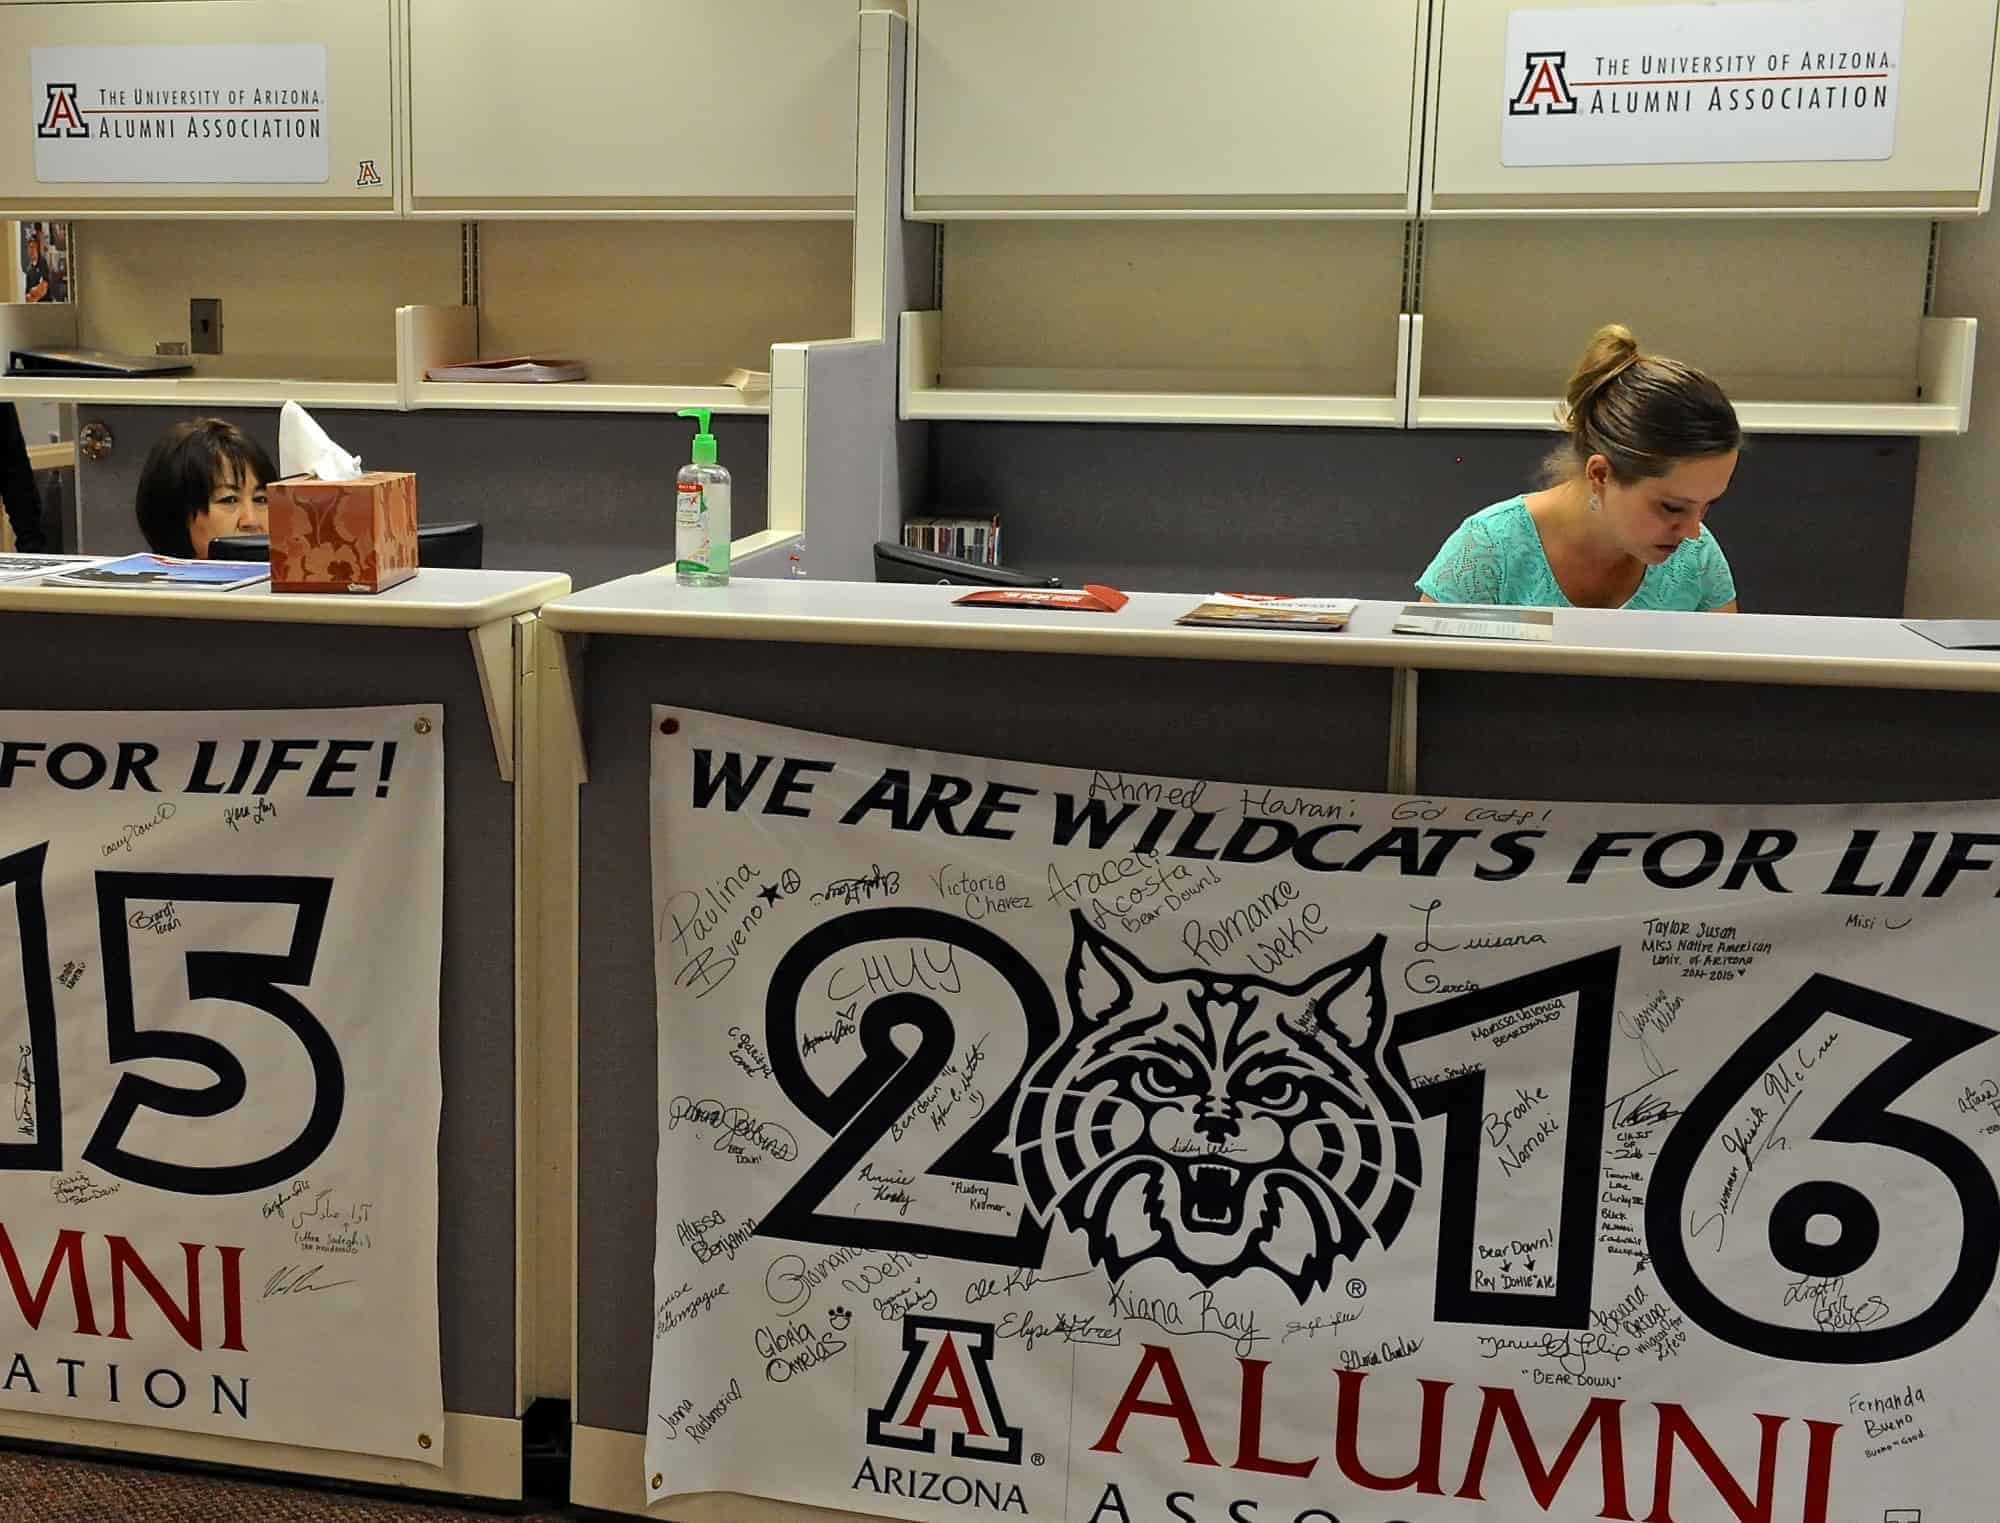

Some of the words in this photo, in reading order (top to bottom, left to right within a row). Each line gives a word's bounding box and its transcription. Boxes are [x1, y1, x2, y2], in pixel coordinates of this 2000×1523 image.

[0, 741, 162, 793] FOR
[183, 739, 398, 798] LIFE!
[692, 748, 836, 818] WE
[838, 767, 1039, 841] ARE
[1051, 793, 1548, 881] WILDCATS
[1566, 828, 1798, 894] FOR
[1820, 829, 2000, 898] LIF
[660, 863, 761, 957] Paulina
[930, 864, 1006, 899] Victoria
[965, 892, 1033, 920] Chavez
[2, 1352, 249, 1420] ATION
[1088, 1343, 1844, 1523] ALUMNI
[851, 1456, 1029, 1515] ARIZONA
